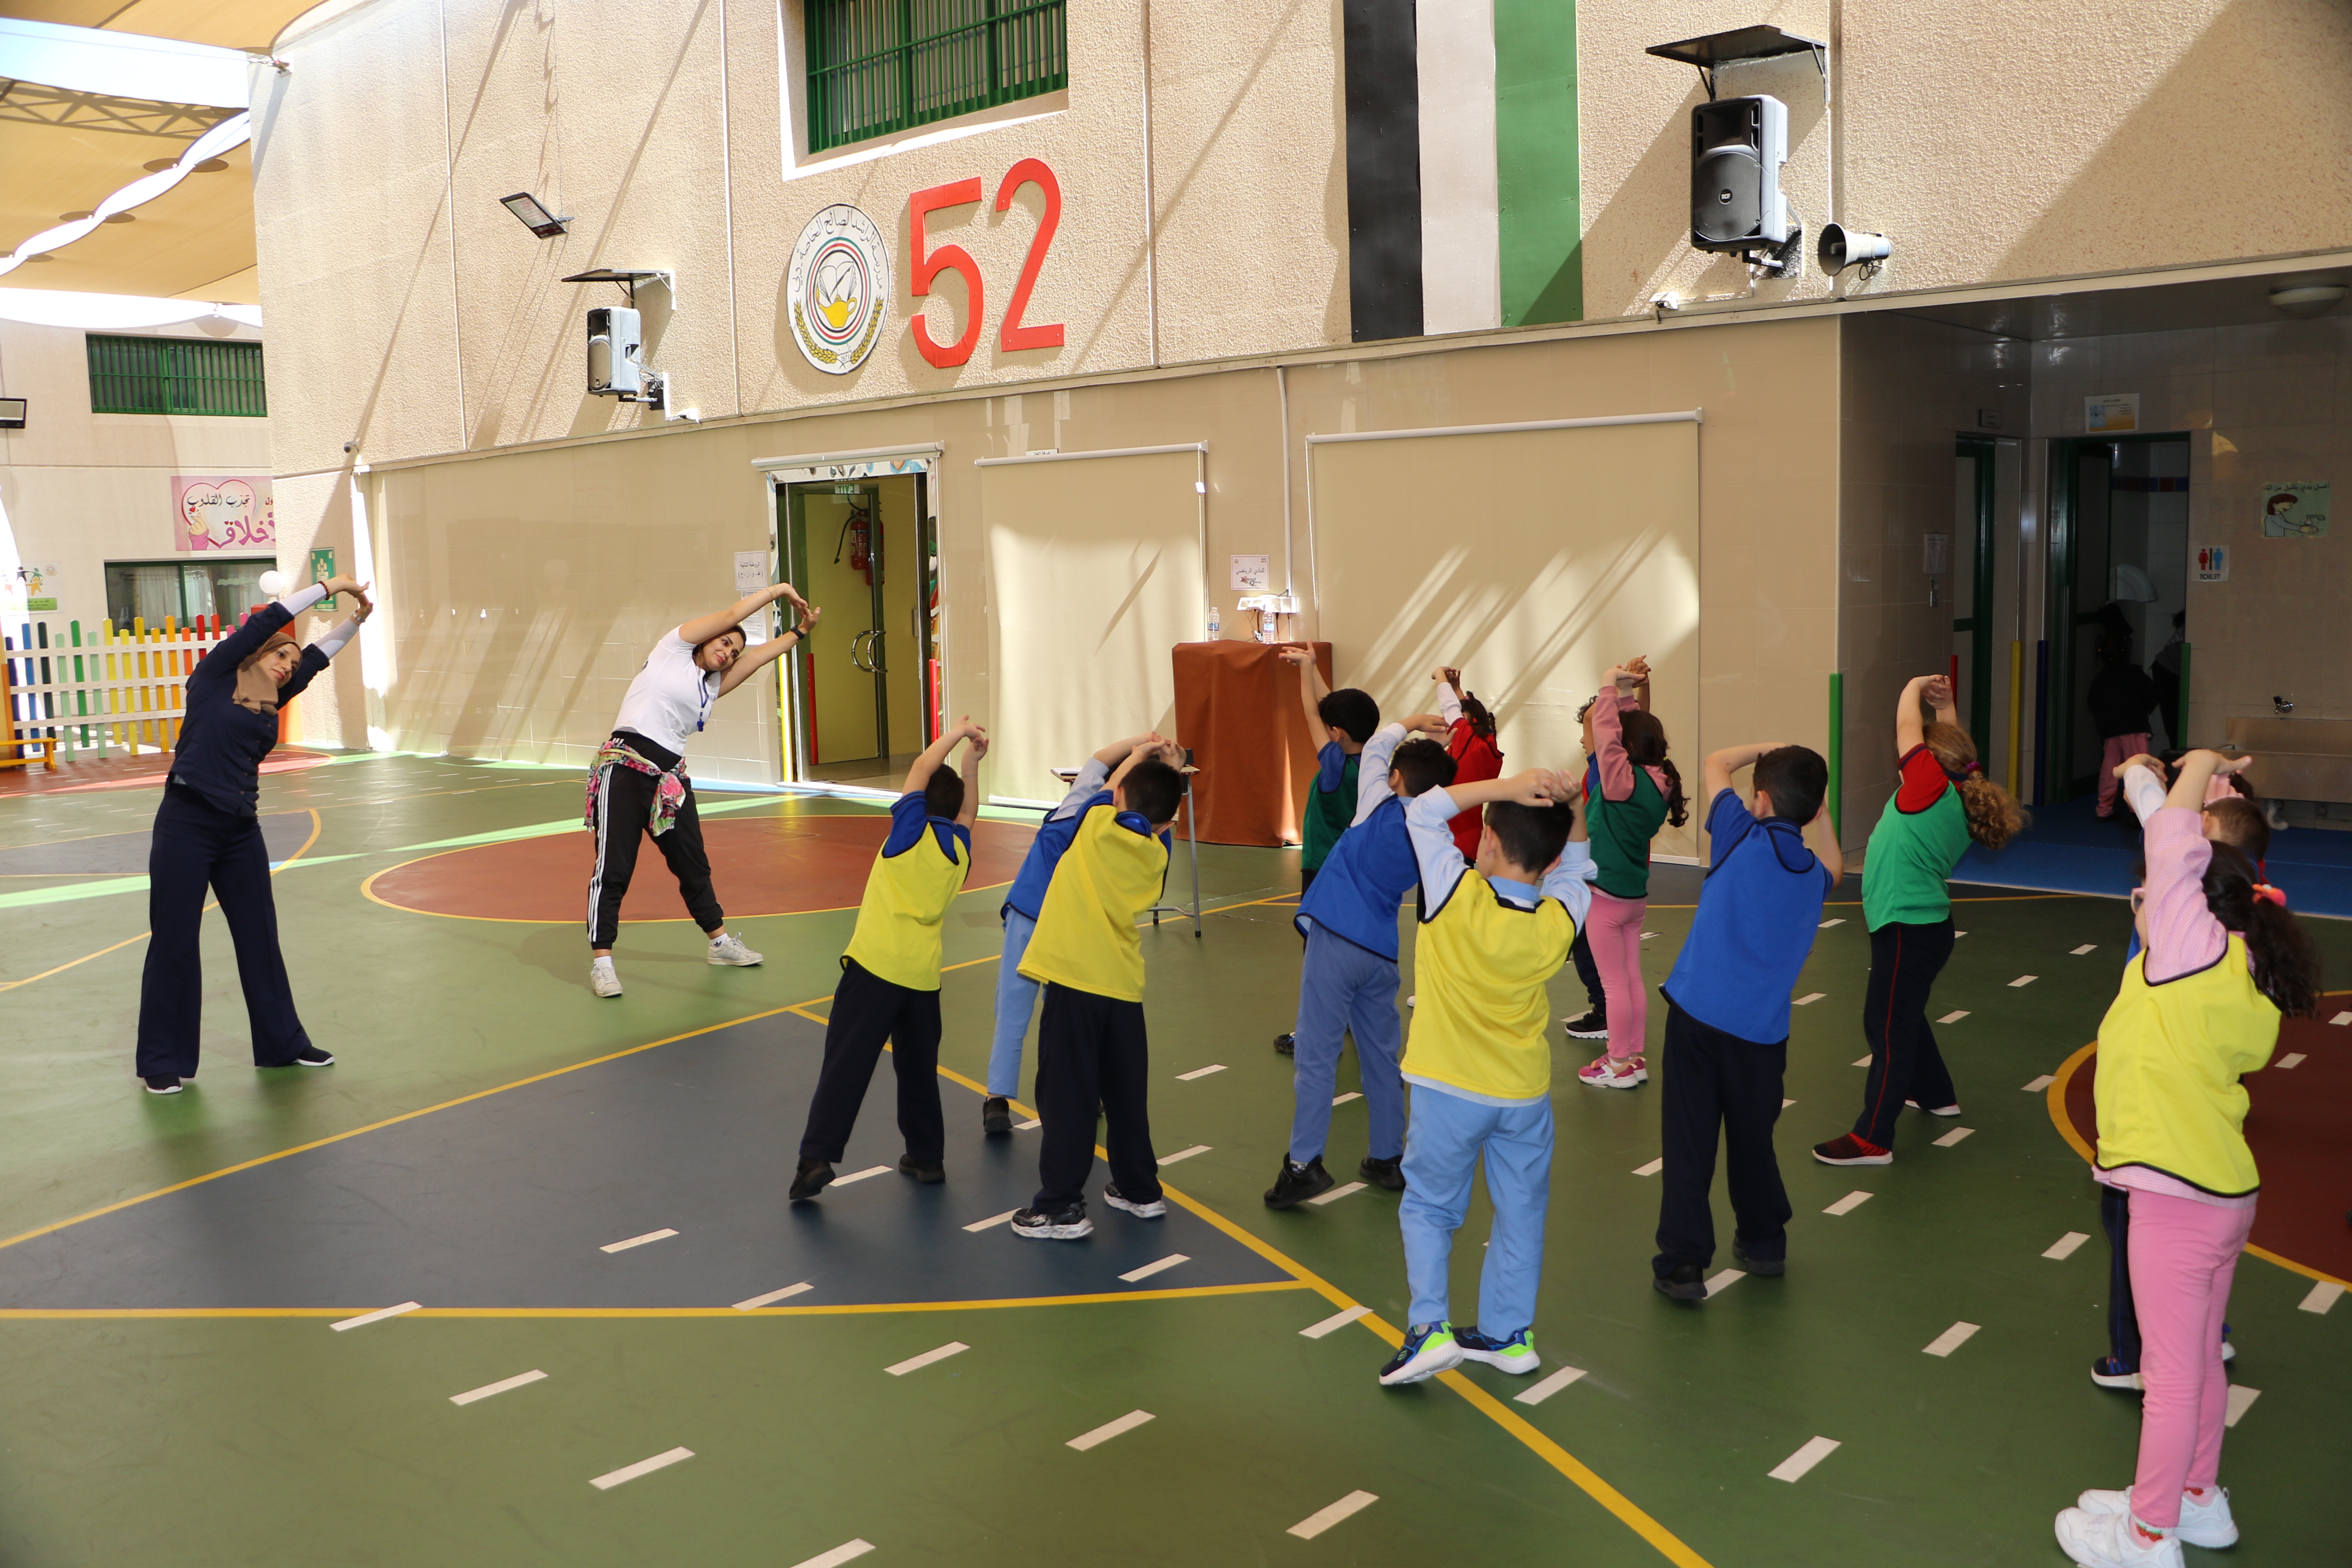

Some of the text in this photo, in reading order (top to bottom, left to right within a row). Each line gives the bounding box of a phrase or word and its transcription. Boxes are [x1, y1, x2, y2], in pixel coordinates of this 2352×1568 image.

[796, 215, 824, 260] الخاصة
[824, 208, 853, 234] الصالح
[910, 158, 1065, 368] 52
[187, 493, 223, 507] القلوب
